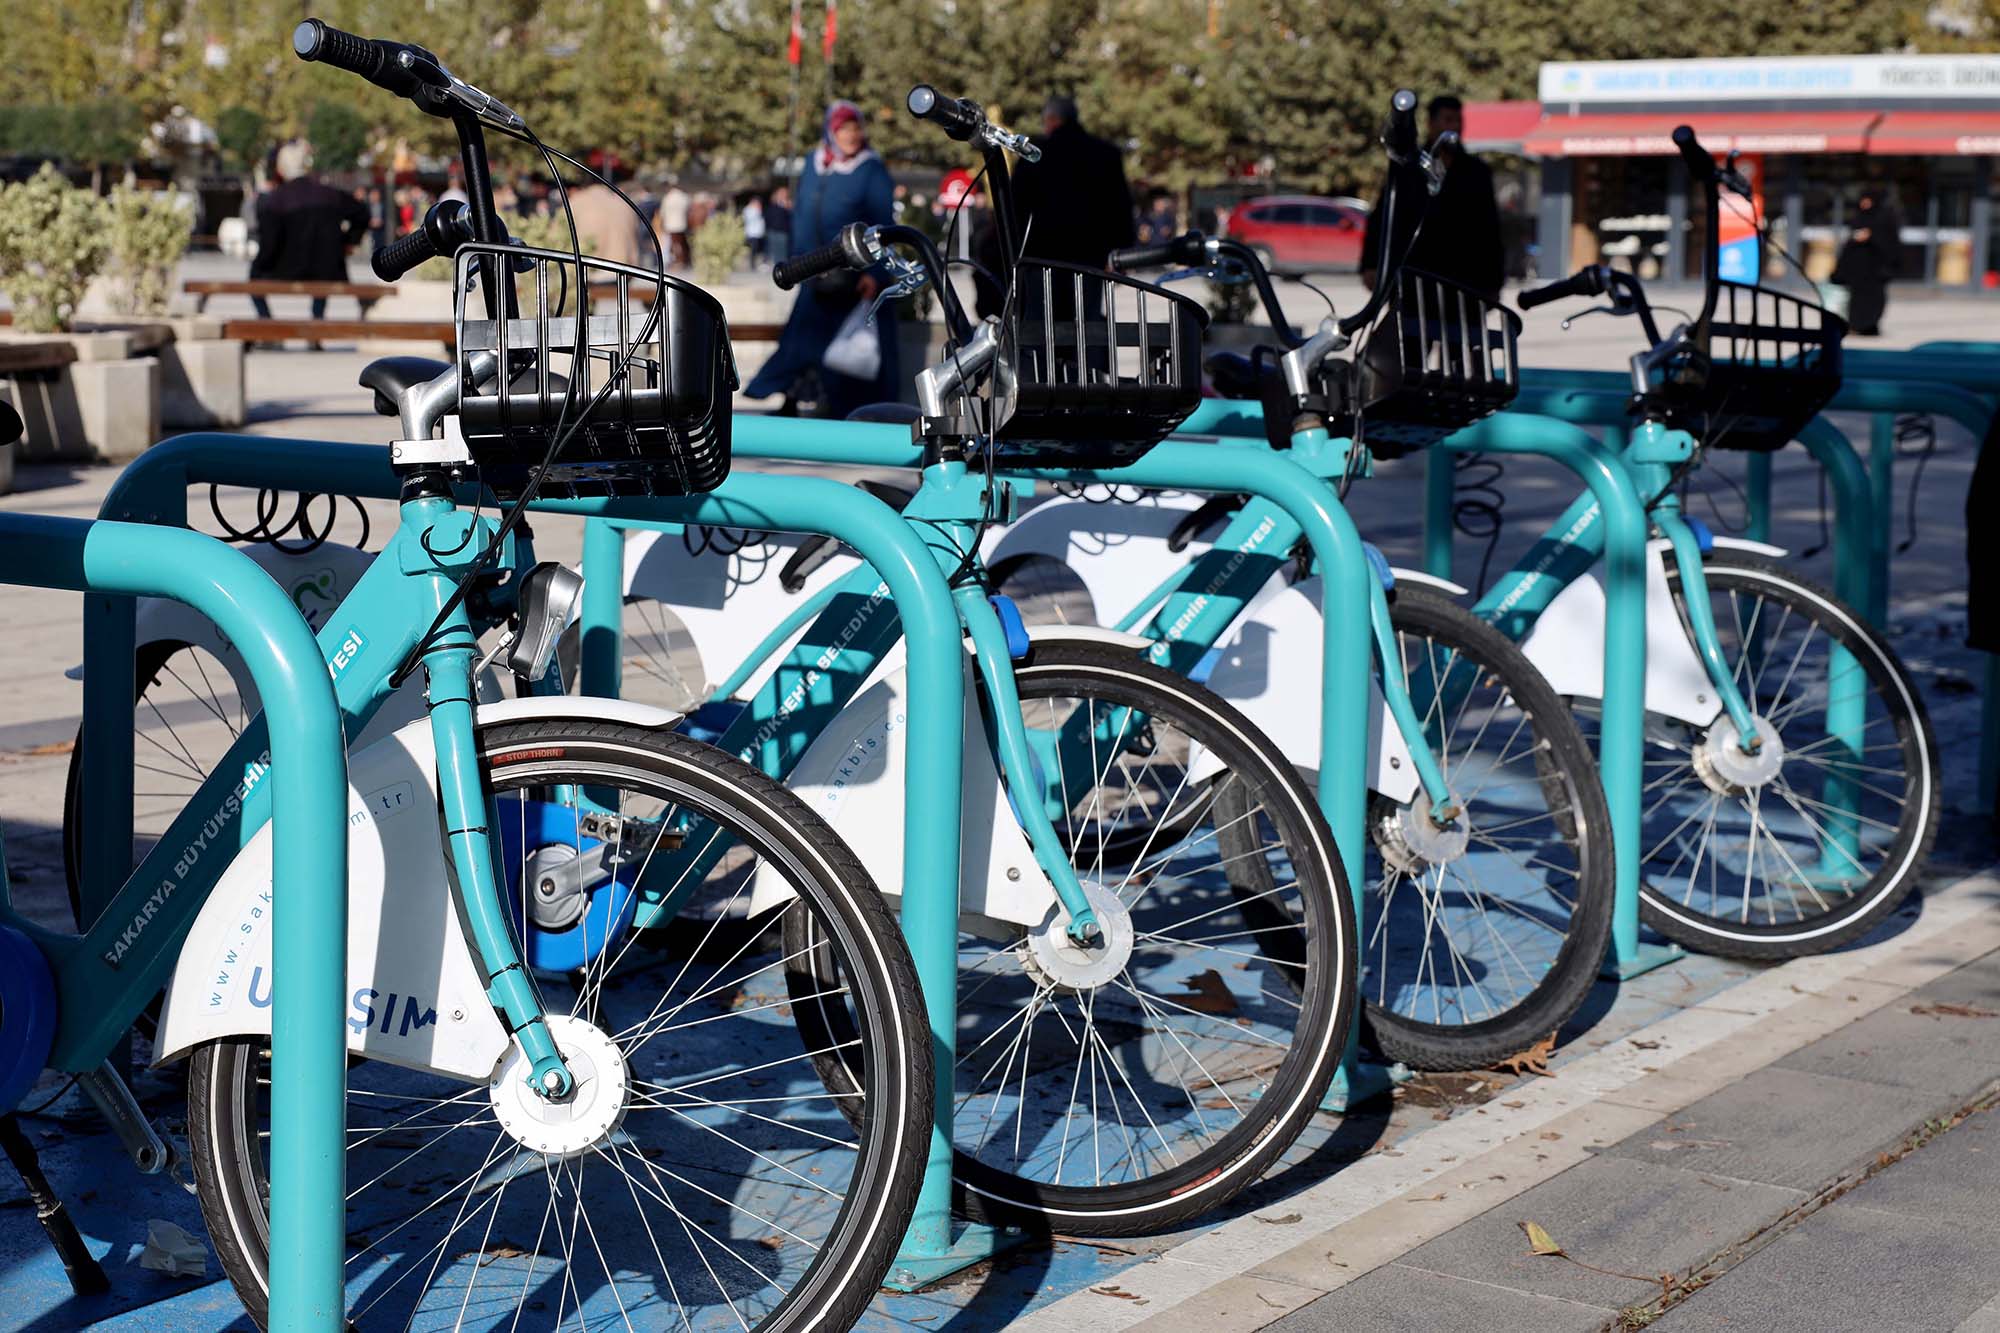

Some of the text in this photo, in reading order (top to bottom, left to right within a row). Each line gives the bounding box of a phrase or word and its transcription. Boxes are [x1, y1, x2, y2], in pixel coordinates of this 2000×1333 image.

[740, 581, 891, 763] ÜYÜKŞEHİR BELEDİYES
[506, 748, 559, 762] STOP THORN
[104, 879, 177, 963] SAKARYA
